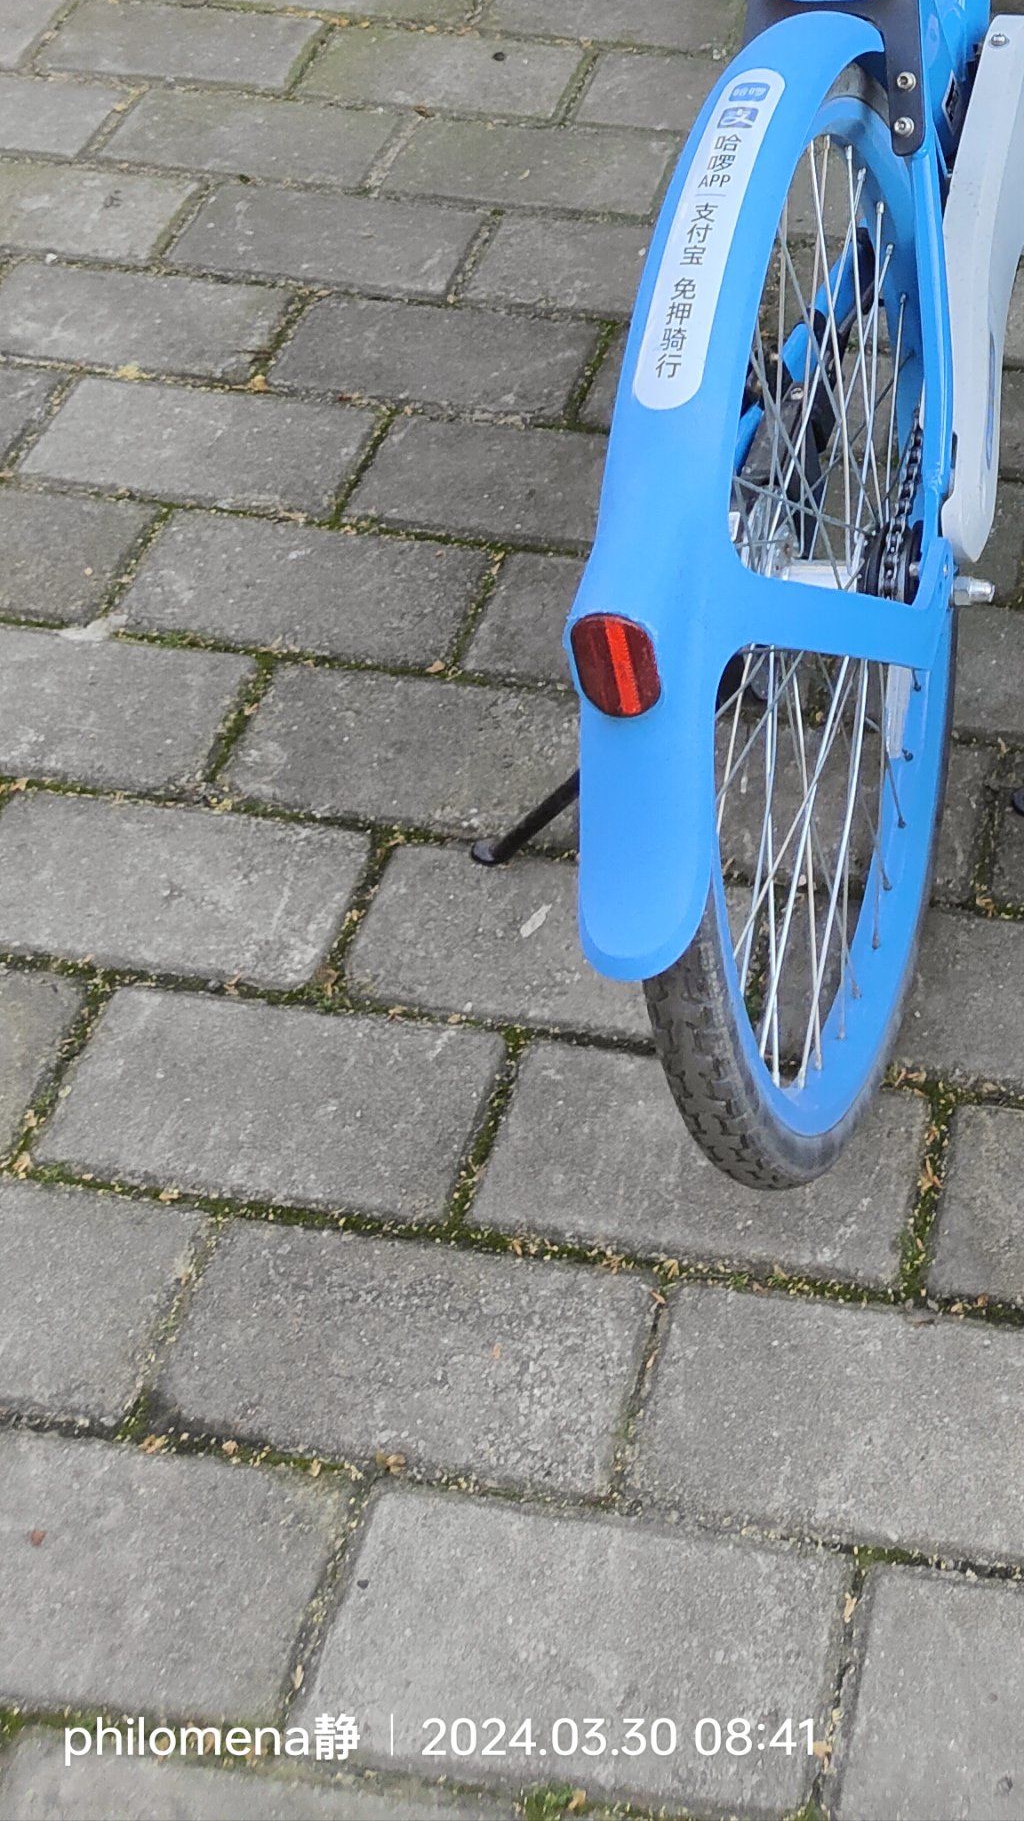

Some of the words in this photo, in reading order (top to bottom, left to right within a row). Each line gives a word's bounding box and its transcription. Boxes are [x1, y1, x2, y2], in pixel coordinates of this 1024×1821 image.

[680, 202, 719, 267] 支付宝
[655, 277, 697, 379] 免押骑行
